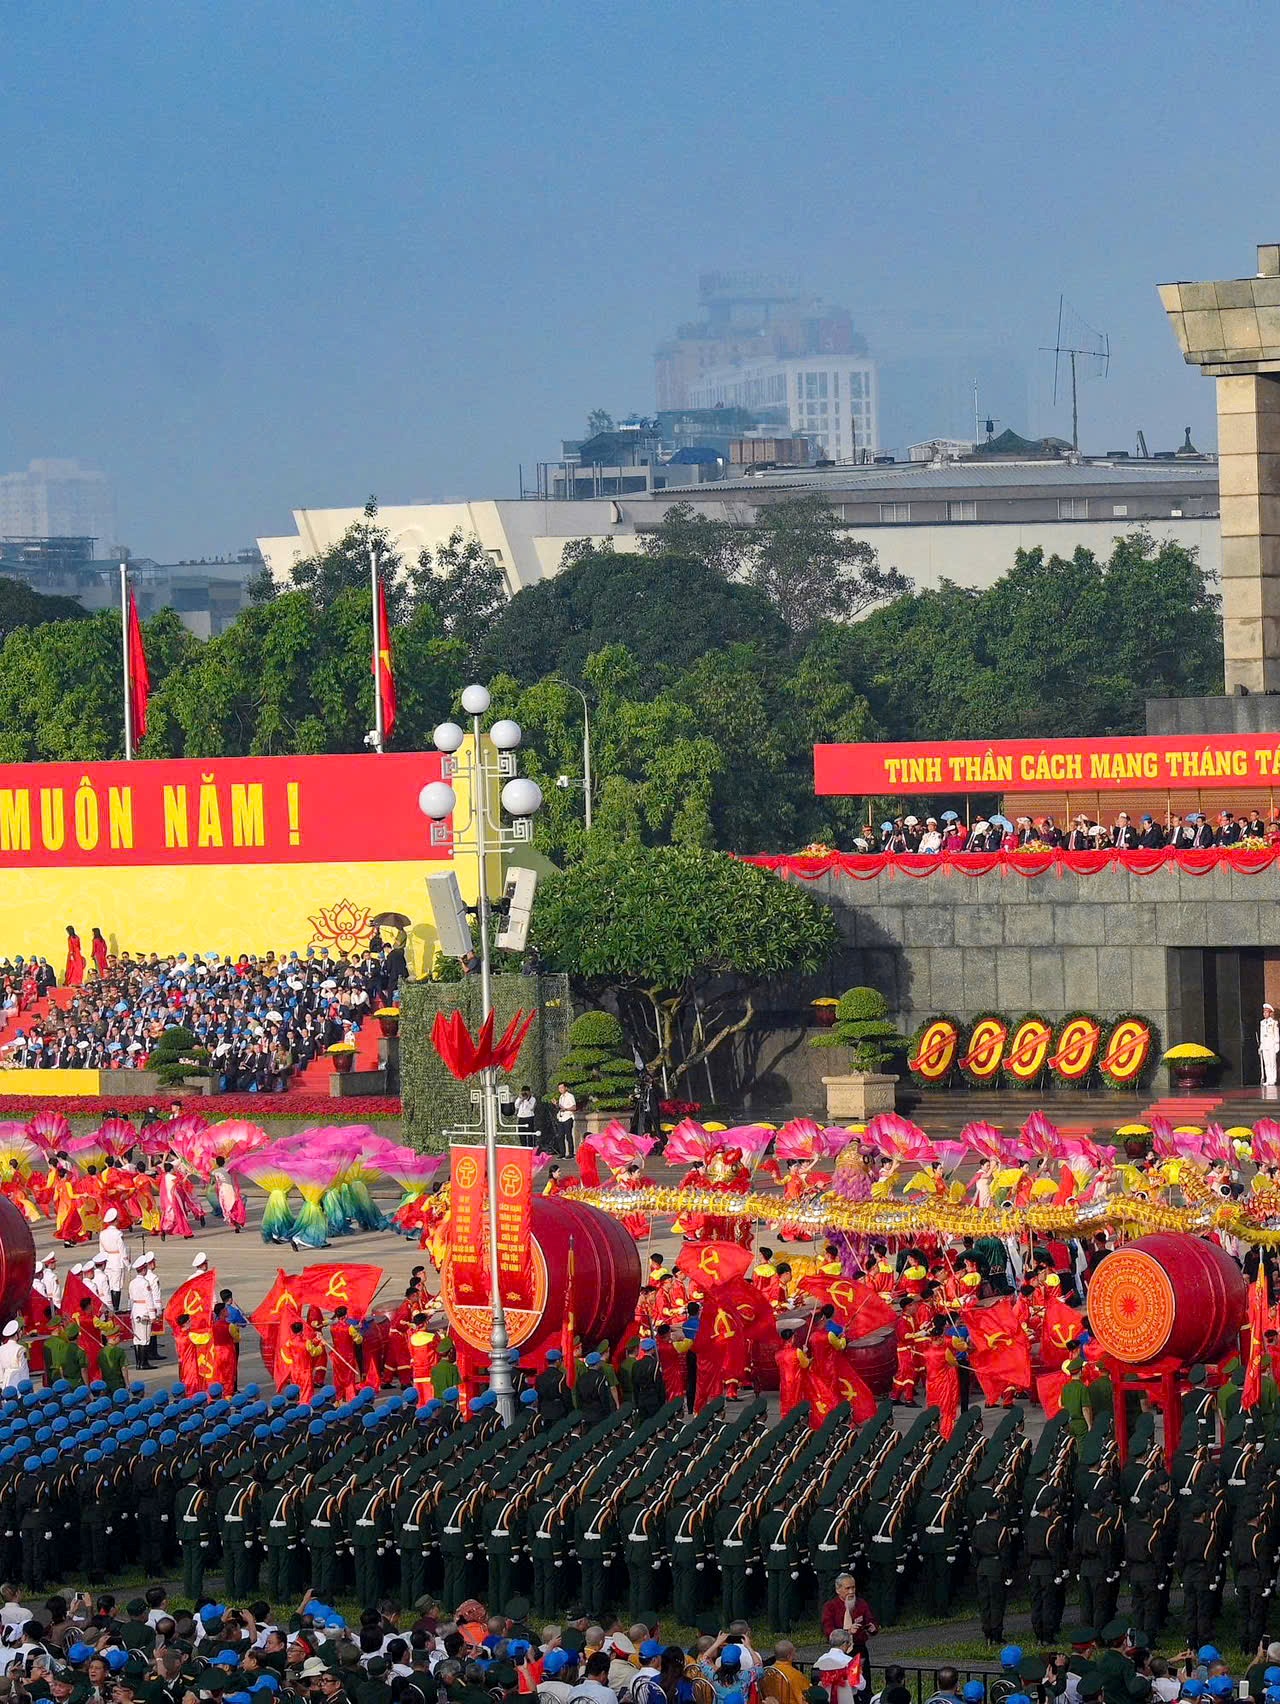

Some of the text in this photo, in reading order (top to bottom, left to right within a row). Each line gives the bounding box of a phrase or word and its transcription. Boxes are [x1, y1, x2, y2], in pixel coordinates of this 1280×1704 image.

[884, 757, 942, 784] TINH
[949, 748, 1013, 782] THẦN
[1021, 750, 1083, 781] CÁCH
[1090, 752, 1159, 784] MẠNG
[1165, 745, 1247, 777] THÁNG
[0, 775, 134, 851] MUÔN
[163, 773, 265, 848] NĂM
